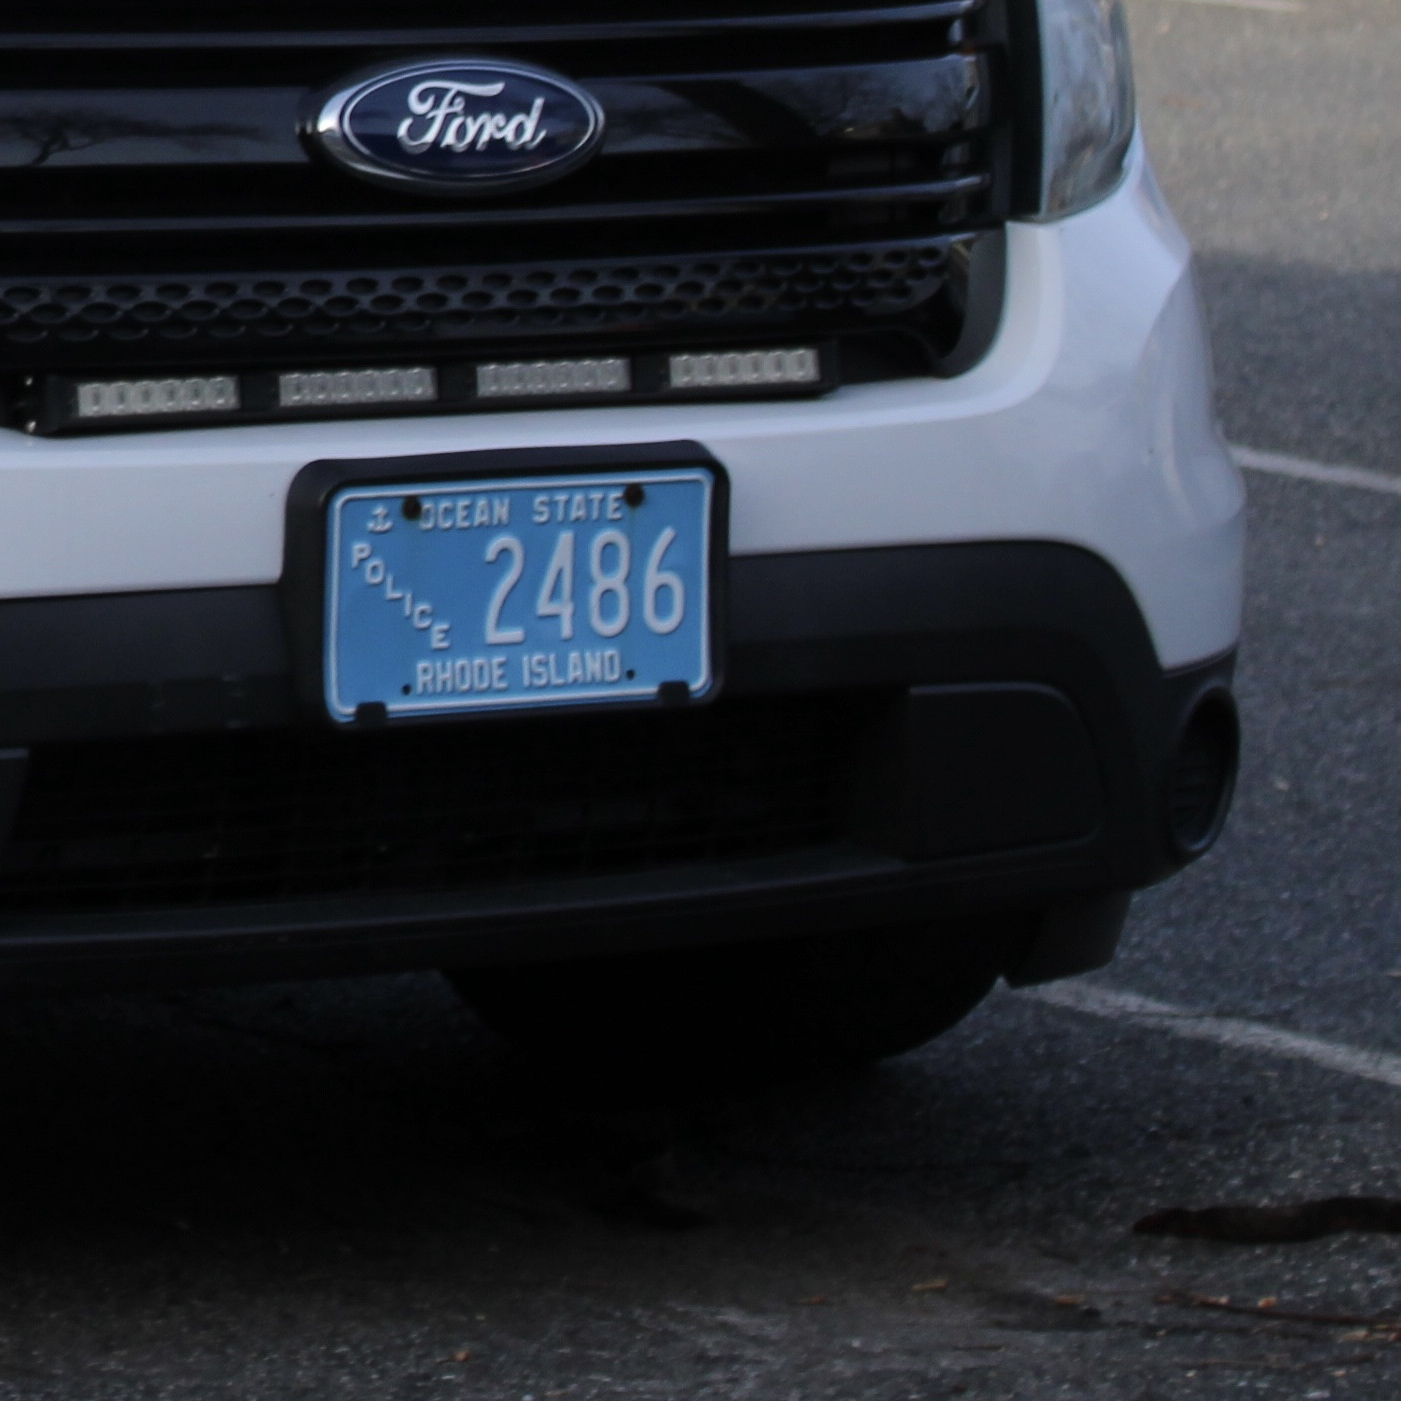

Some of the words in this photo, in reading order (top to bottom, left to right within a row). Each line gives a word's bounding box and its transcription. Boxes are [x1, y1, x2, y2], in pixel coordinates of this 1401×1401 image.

[397, 81, 546, 154] Ford
[417, 499, 510, 531] OCEAN
[532, 493, 624, 524] STATE
[350, 541, 451, 650] POLICE
[484, 526, 685, 646] 2486
[415, 655, 509, 696] RHODE
[522, 650, 621, 689] ISLAND
